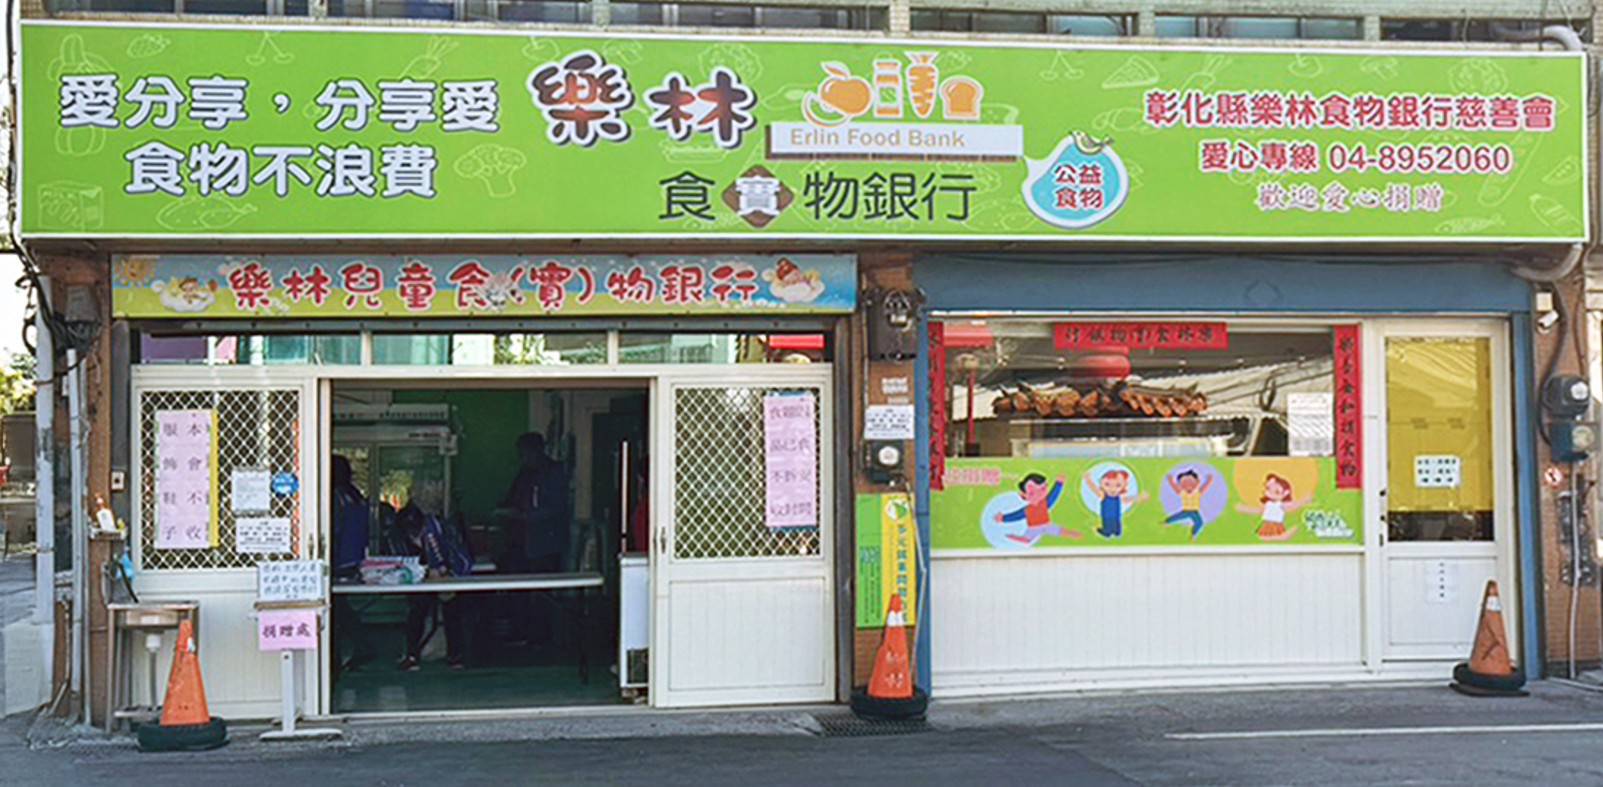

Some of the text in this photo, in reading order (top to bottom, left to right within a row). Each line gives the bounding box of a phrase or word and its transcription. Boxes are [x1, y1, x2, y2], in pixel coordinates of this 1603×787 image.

[60, 74, 500, 132] 愛分享，分享愛
[528, 51, 756, 148] 樂林
[1145, 90, 1555, 132] 彰化縣樂林食物銀行慈善會
[790, 127, 966, 149] Erlin Food Bank
[125, 142, 437, 198] 食物不浪費
[1202, 142, 1511, 173] 愛心專線 04-8952060
[1055, 164, 1103, 186] 公益
[1055, 188, 1104, 210] 食物
[1258, 183, 1444, 214] 歡迎愛心捐贈
